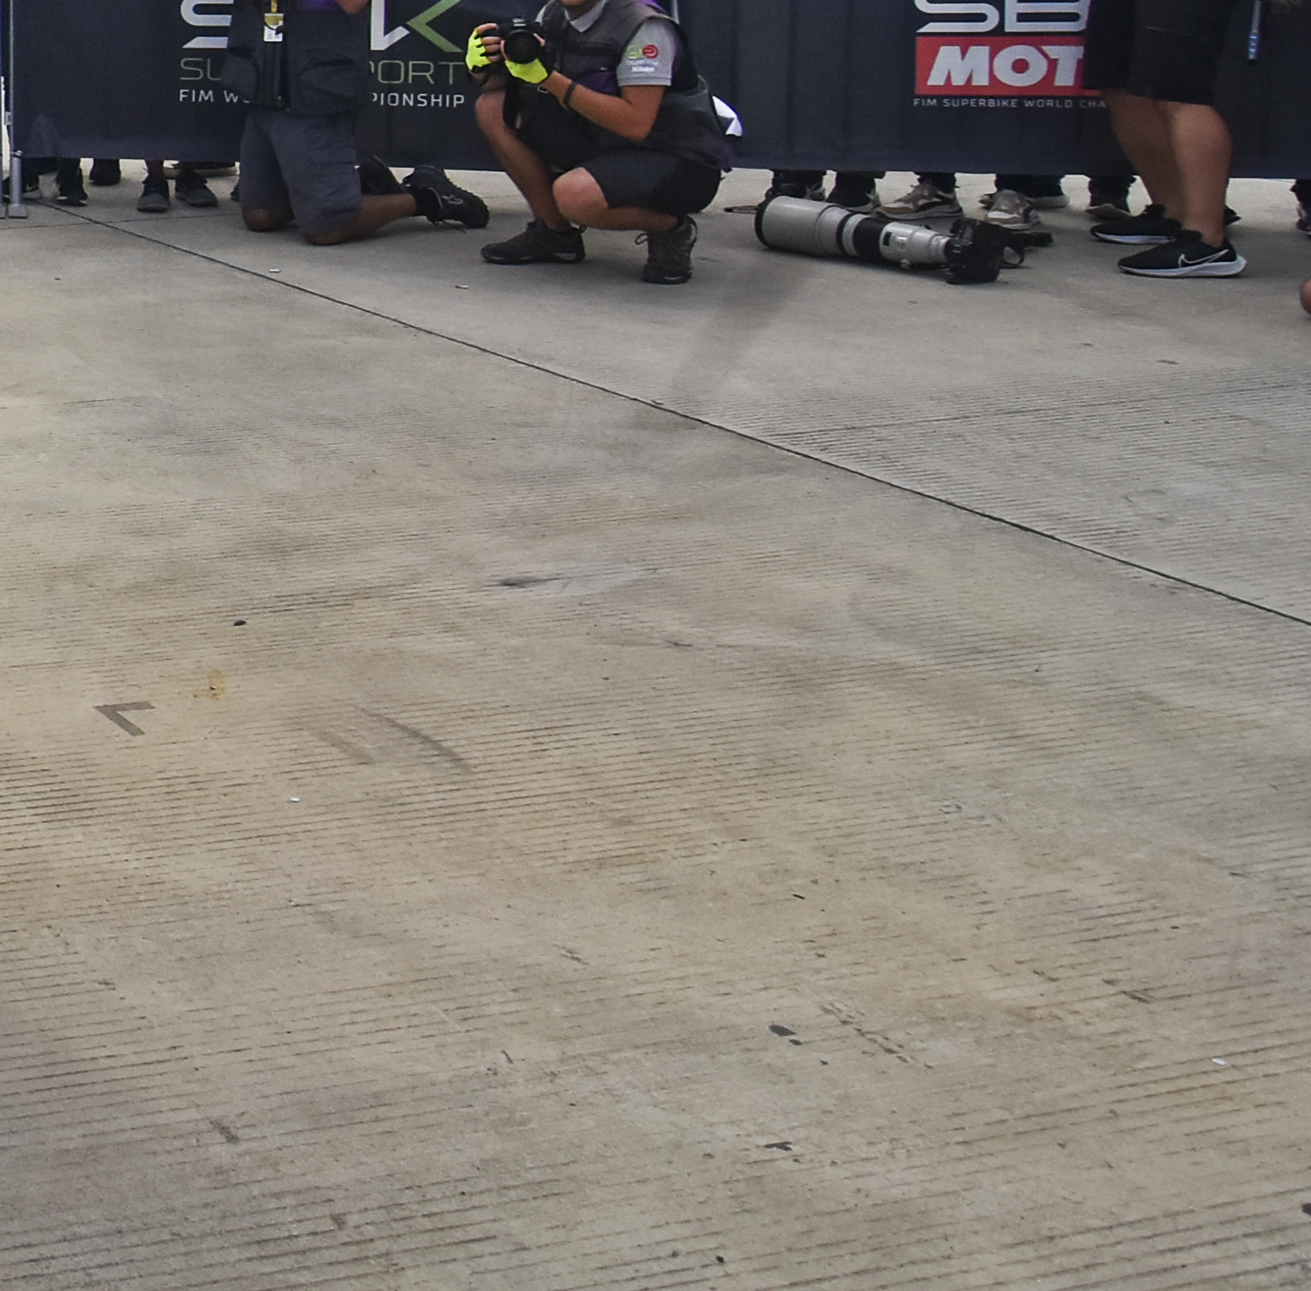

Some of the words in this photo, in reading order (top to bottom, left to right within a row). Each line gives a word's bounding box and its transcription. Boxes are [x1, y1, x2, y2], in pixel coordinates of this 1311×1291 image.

[927, 44, 1084, 87] MOT
[179, 89, 215, 103] FIM
[913, 98, 938, 107] FIM
[943, 98, 1019, 108] SUPERBIKE
[1024, 99, 1073, 108] WORLD
